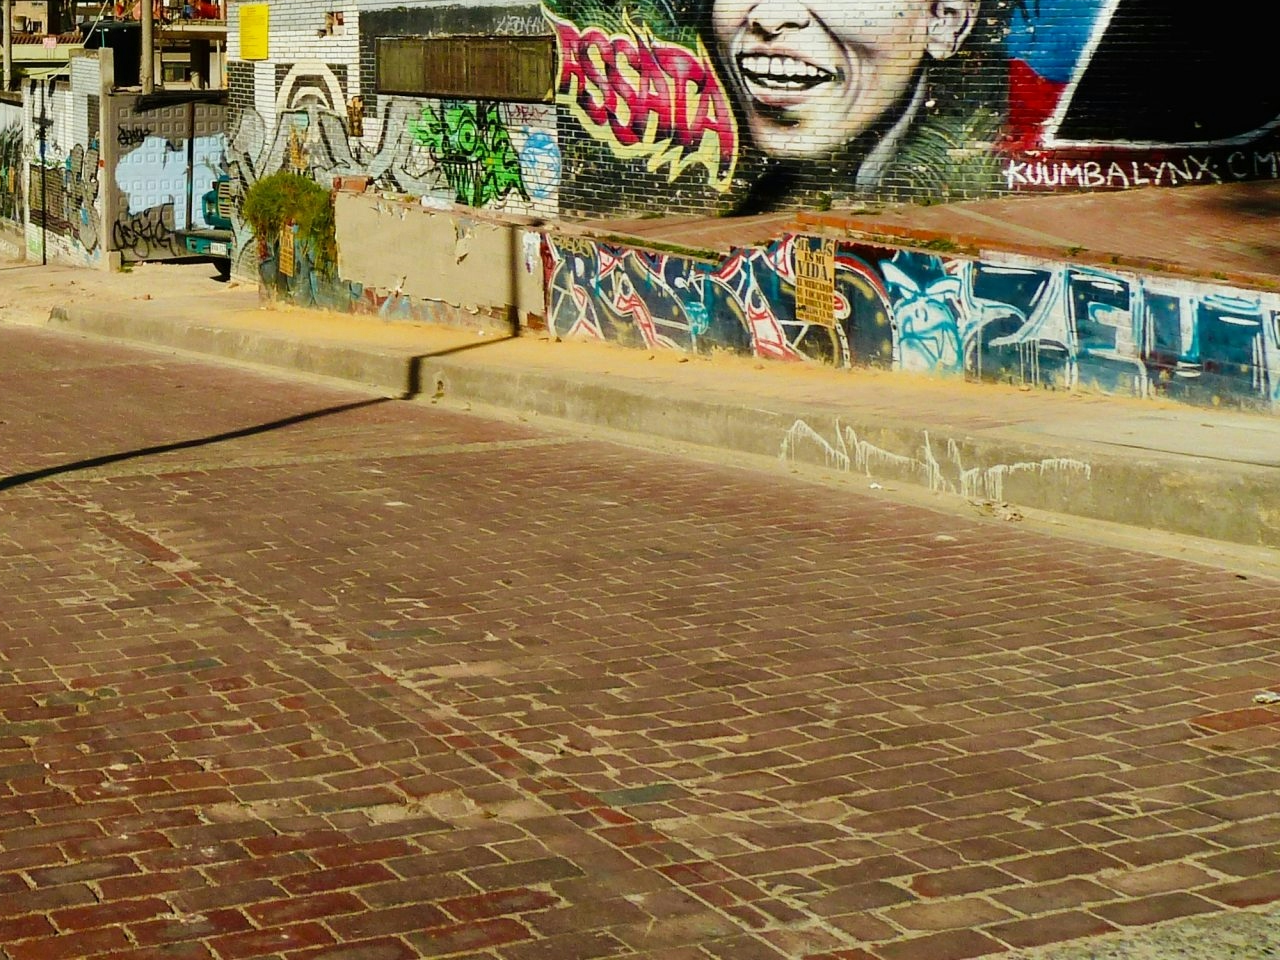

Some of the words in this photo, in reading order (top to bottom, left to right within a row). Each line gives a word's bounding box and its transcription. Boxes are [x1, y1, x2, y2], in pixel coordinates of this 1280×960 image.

[552, 14, 739, 188] ASSATA
[1227, 150, 1280, 179] CM
[797, 260, 833, 284] VIDA,
